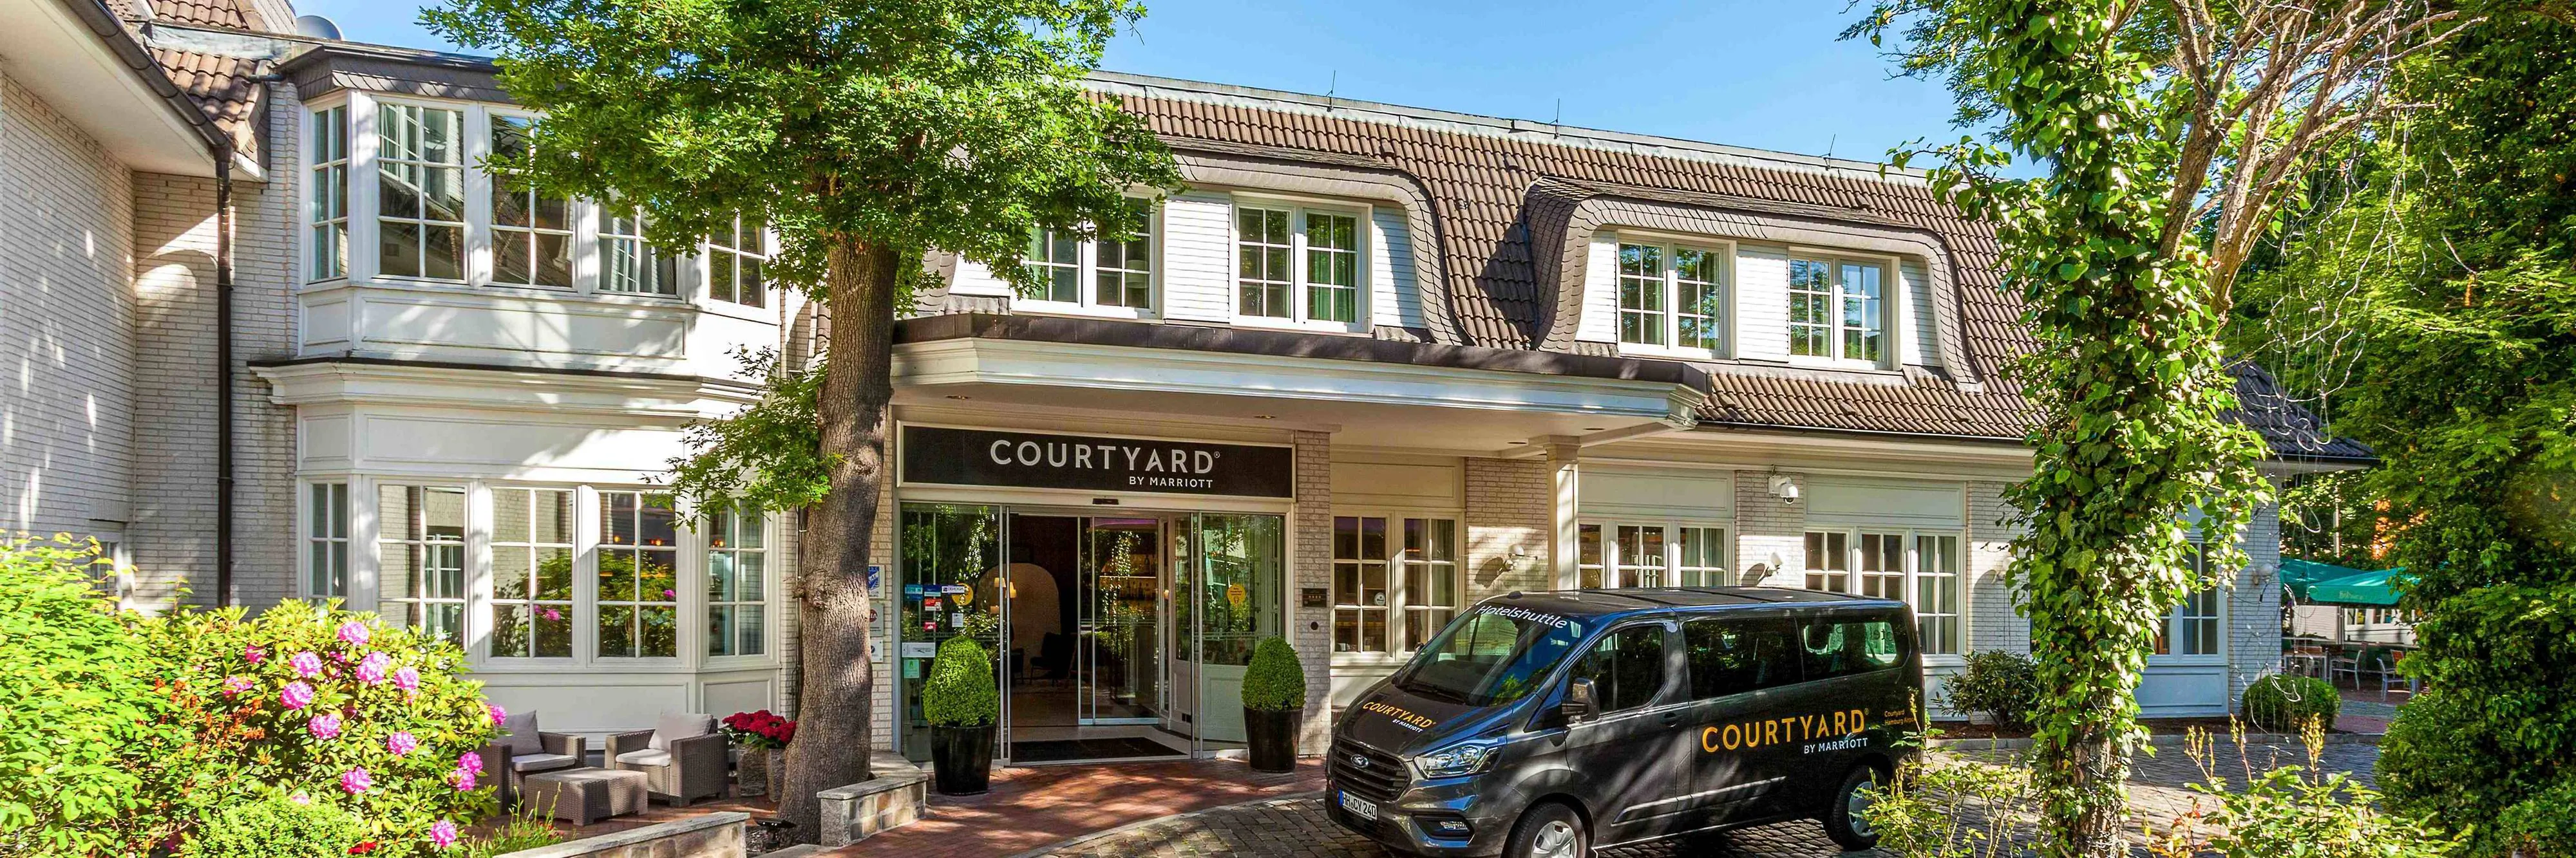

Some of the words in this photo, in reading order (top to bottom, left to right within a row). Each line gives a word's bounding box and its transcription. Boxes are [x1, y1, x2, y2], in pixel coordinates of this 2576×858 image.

[1129, 476, 1144, 485] BY
[1150, 476, 1213, 489] MARRIOTT
[1475, 605, 1567, 629] Hotelshuttle
[1398, 721, 1423, 733] MARRIOTT
[1804, 744, 1815, 754] BY
[1818, 738, 1868, 752] MARRIOTT
